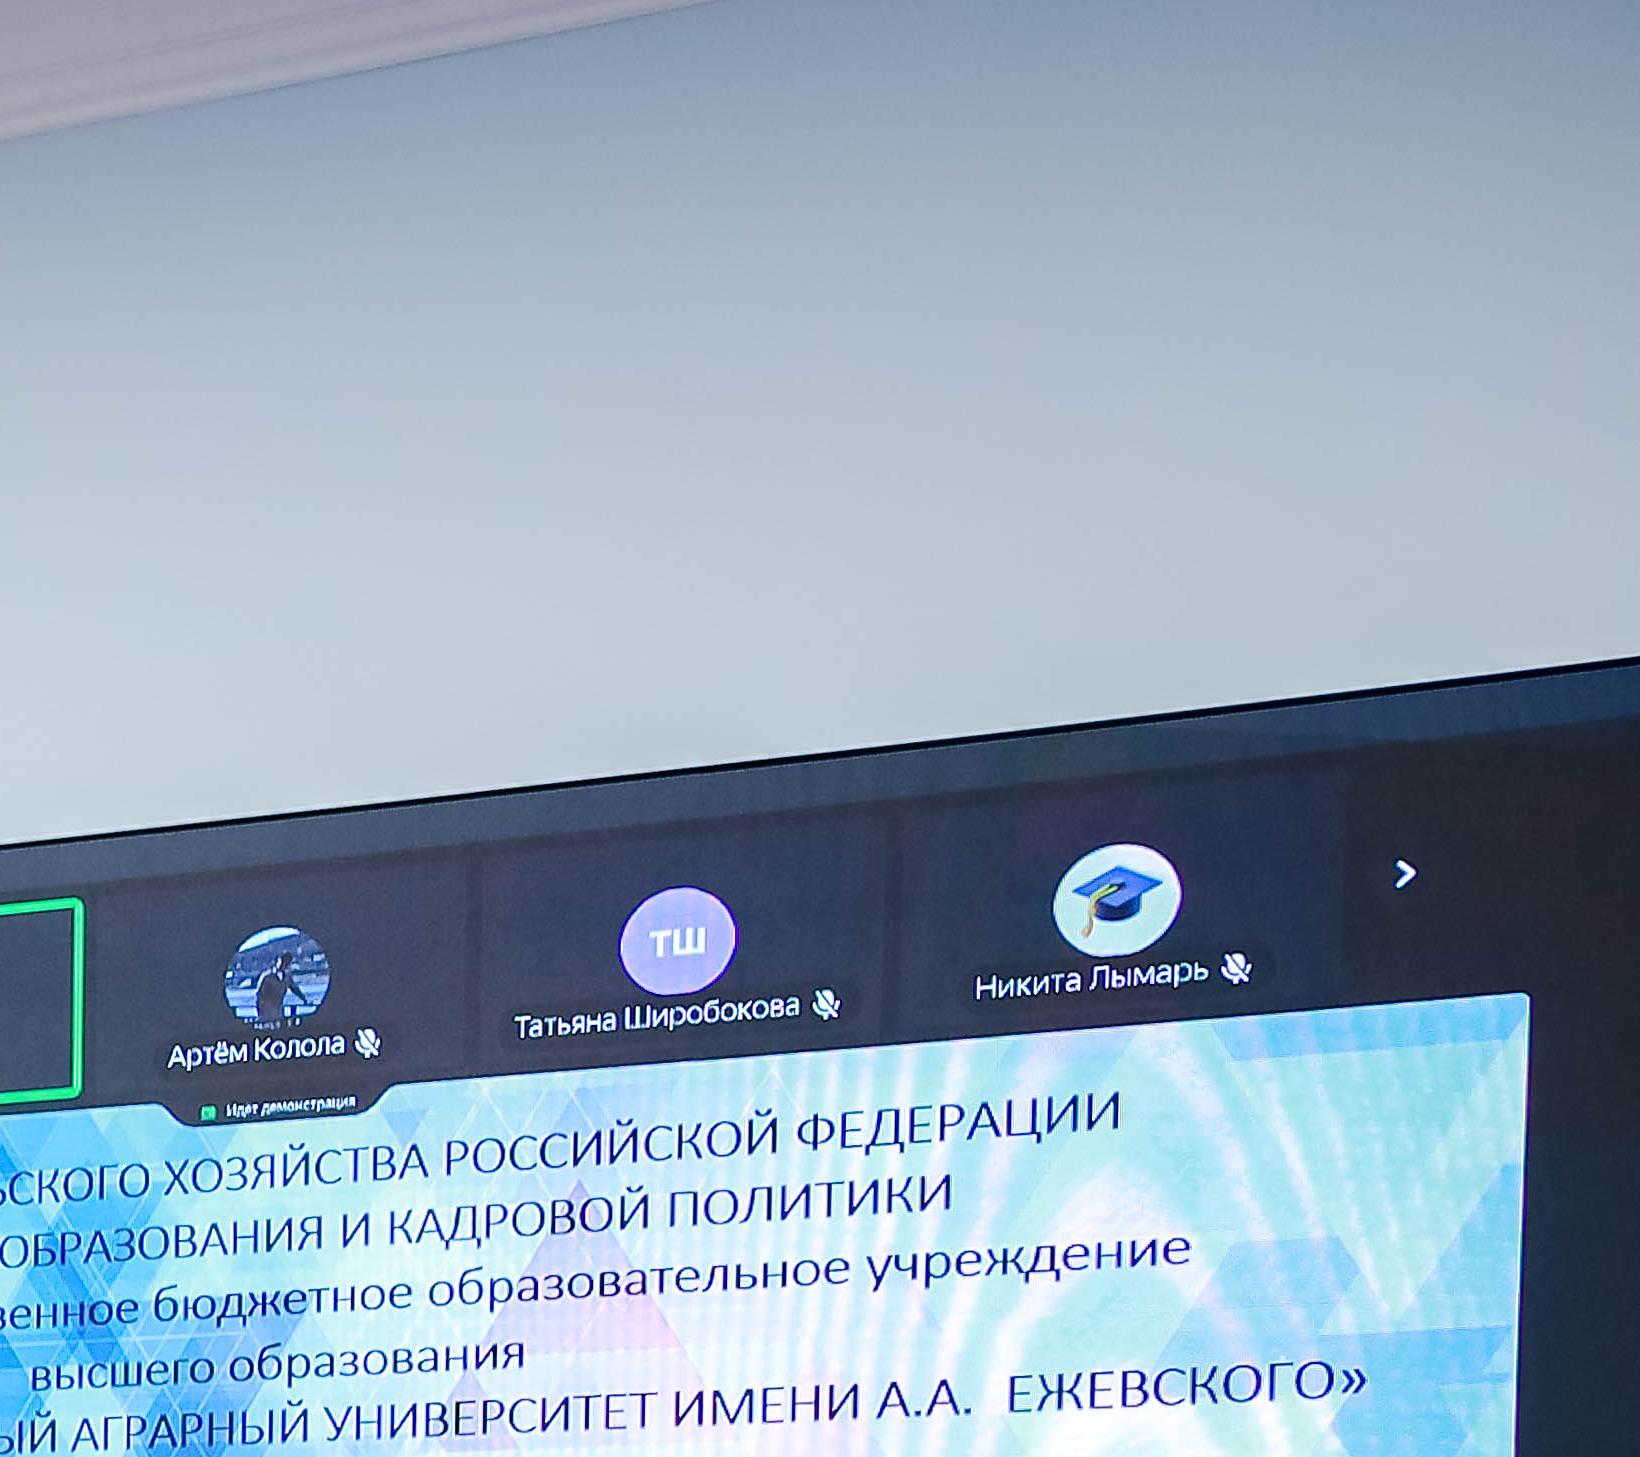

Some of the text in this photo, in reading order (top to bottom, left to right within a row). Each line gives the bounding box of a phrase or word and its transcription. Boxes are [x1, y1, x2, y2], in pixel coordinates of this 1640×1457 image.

[649, 927, 707, 958] ТШ
[975, 958, 1210, 1000] Никита Лымарь
[514, 996, 800, 1040] Татьяна Широбокова
[167, 1034, 345, 1071] Артём Колола
[163, 1141, 429, 1197] ХОЗЯЙСТВА
[446, 1108, 780, 1177] РОССИЙСКОЙ
[796, 1090, 1122, 1156] ФЕДЕРАЦИИ
[342, 1213, 371, 1250] И
[388, 1185, 650, 1250] КАДРОВОЙ
[669, 1173, 952, 1229] ПОЛИТИКИ
[154, 1280, 412, 1329] бюджетное
[429, 1254, 849, 1306] образовательное
[866, 1236, 1191, 1292] учреждение
[31, 1340, 525, 1392] высшего образования
[71, 1400, 308, 1452] АГРАРНЫЙ
[324, 1391, 658, 1443] УНИВЕРСИТЕТ
[675, 1382, 859, 1427] ИМЕНИ
[876, 1377, 973, 1419] А.А.
[1008, 1362, 1366, 1414] ЕЖЕВСКОГО»
